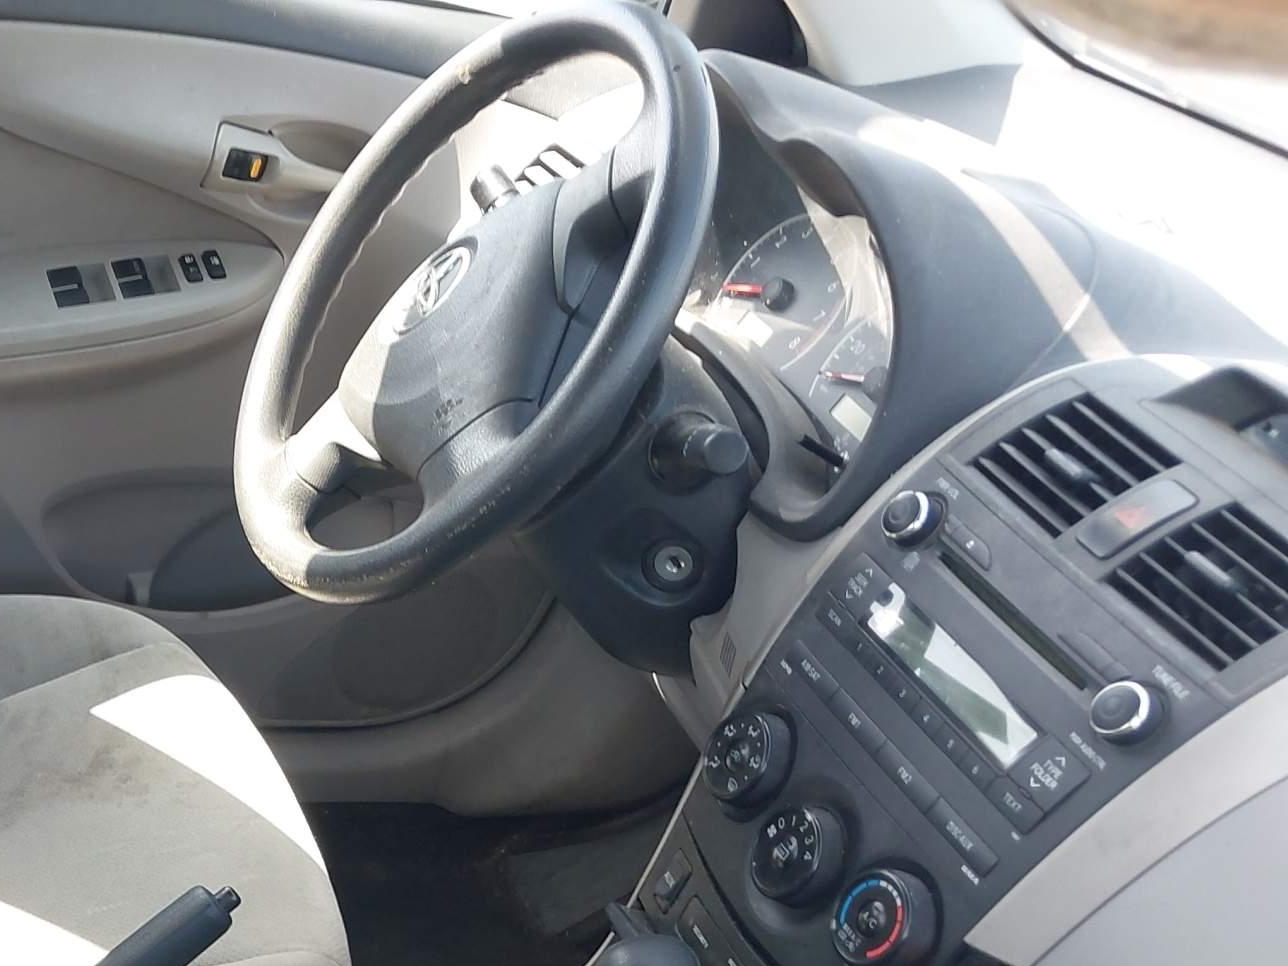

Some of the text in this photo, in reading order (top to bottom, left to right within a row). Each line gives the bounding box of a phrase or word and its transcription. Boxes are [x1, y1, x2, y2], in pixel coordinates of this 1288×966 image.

[775, 235, 787, 248] 2
[812, 309, 826, 321] 7
[788, 336, 801, 349] 8
[1030, 762, 1059, 790] FOLDER
[1043, 759, 1063, 780] TYPE
[1002, 792, 1023, 812] TEXT
[777, 816, 785, 830] 0
[799, 820, 809, 833] 2
[804, 834, 814, 846] 3
[803, 850, 813, 860] 4
